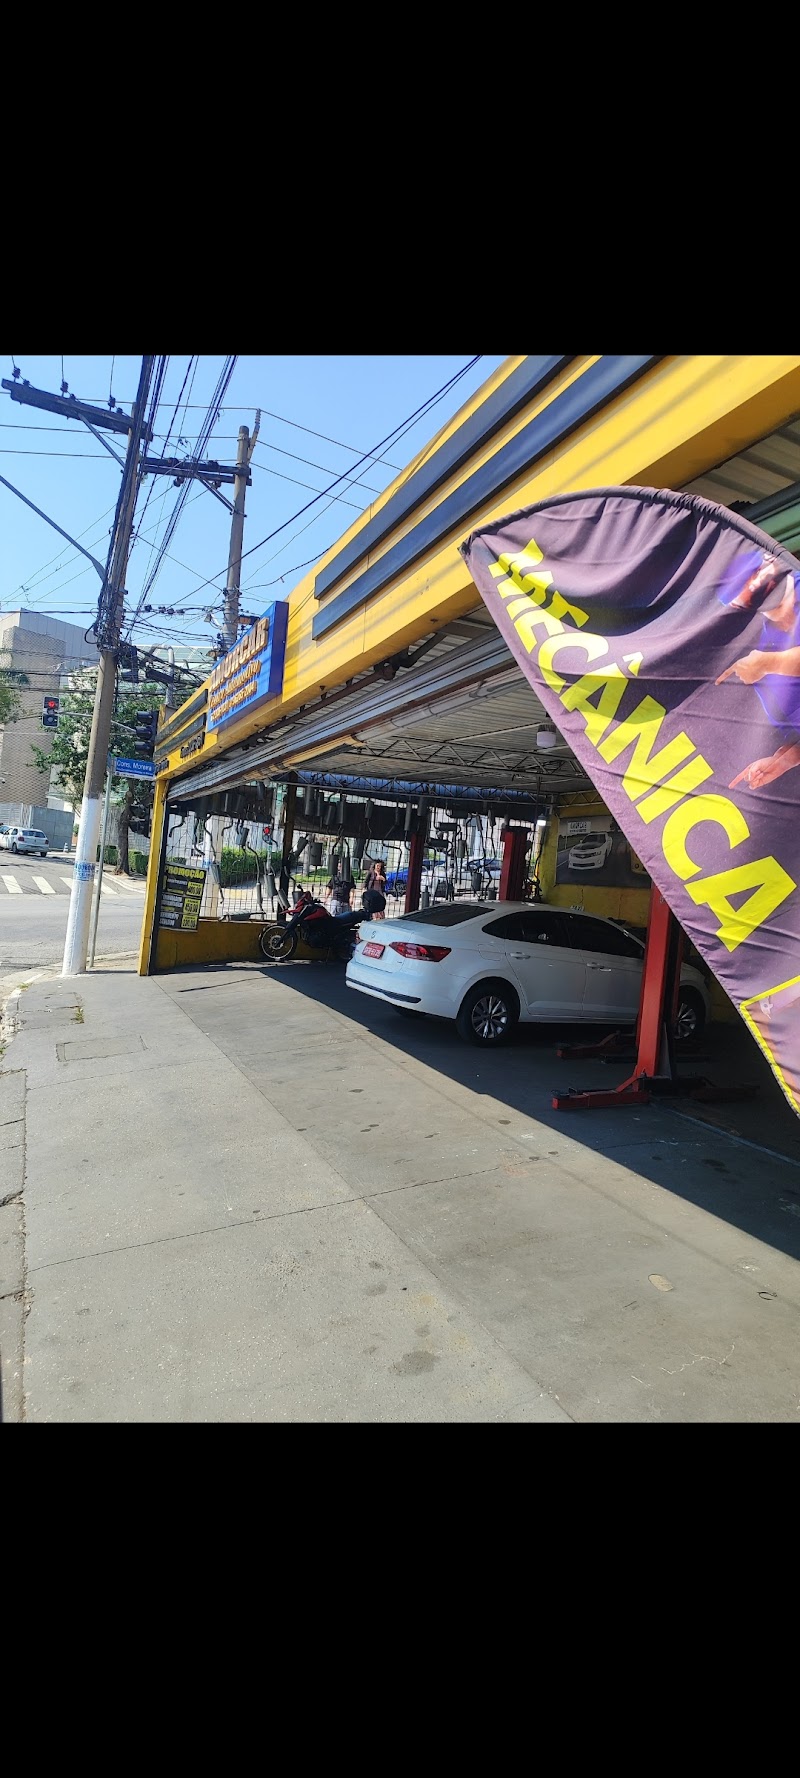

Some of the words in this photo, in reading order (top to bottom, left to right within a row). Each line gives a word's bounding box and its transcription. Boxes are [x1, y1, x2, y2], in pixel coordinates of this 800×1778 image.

[488, 539, 797, 953] MECÂNICA
[116, 760, 131, 769] Cons.
[133, 762, 152, 771] Moreira
[164, 865, 205, 880] PROMOÇÃO
